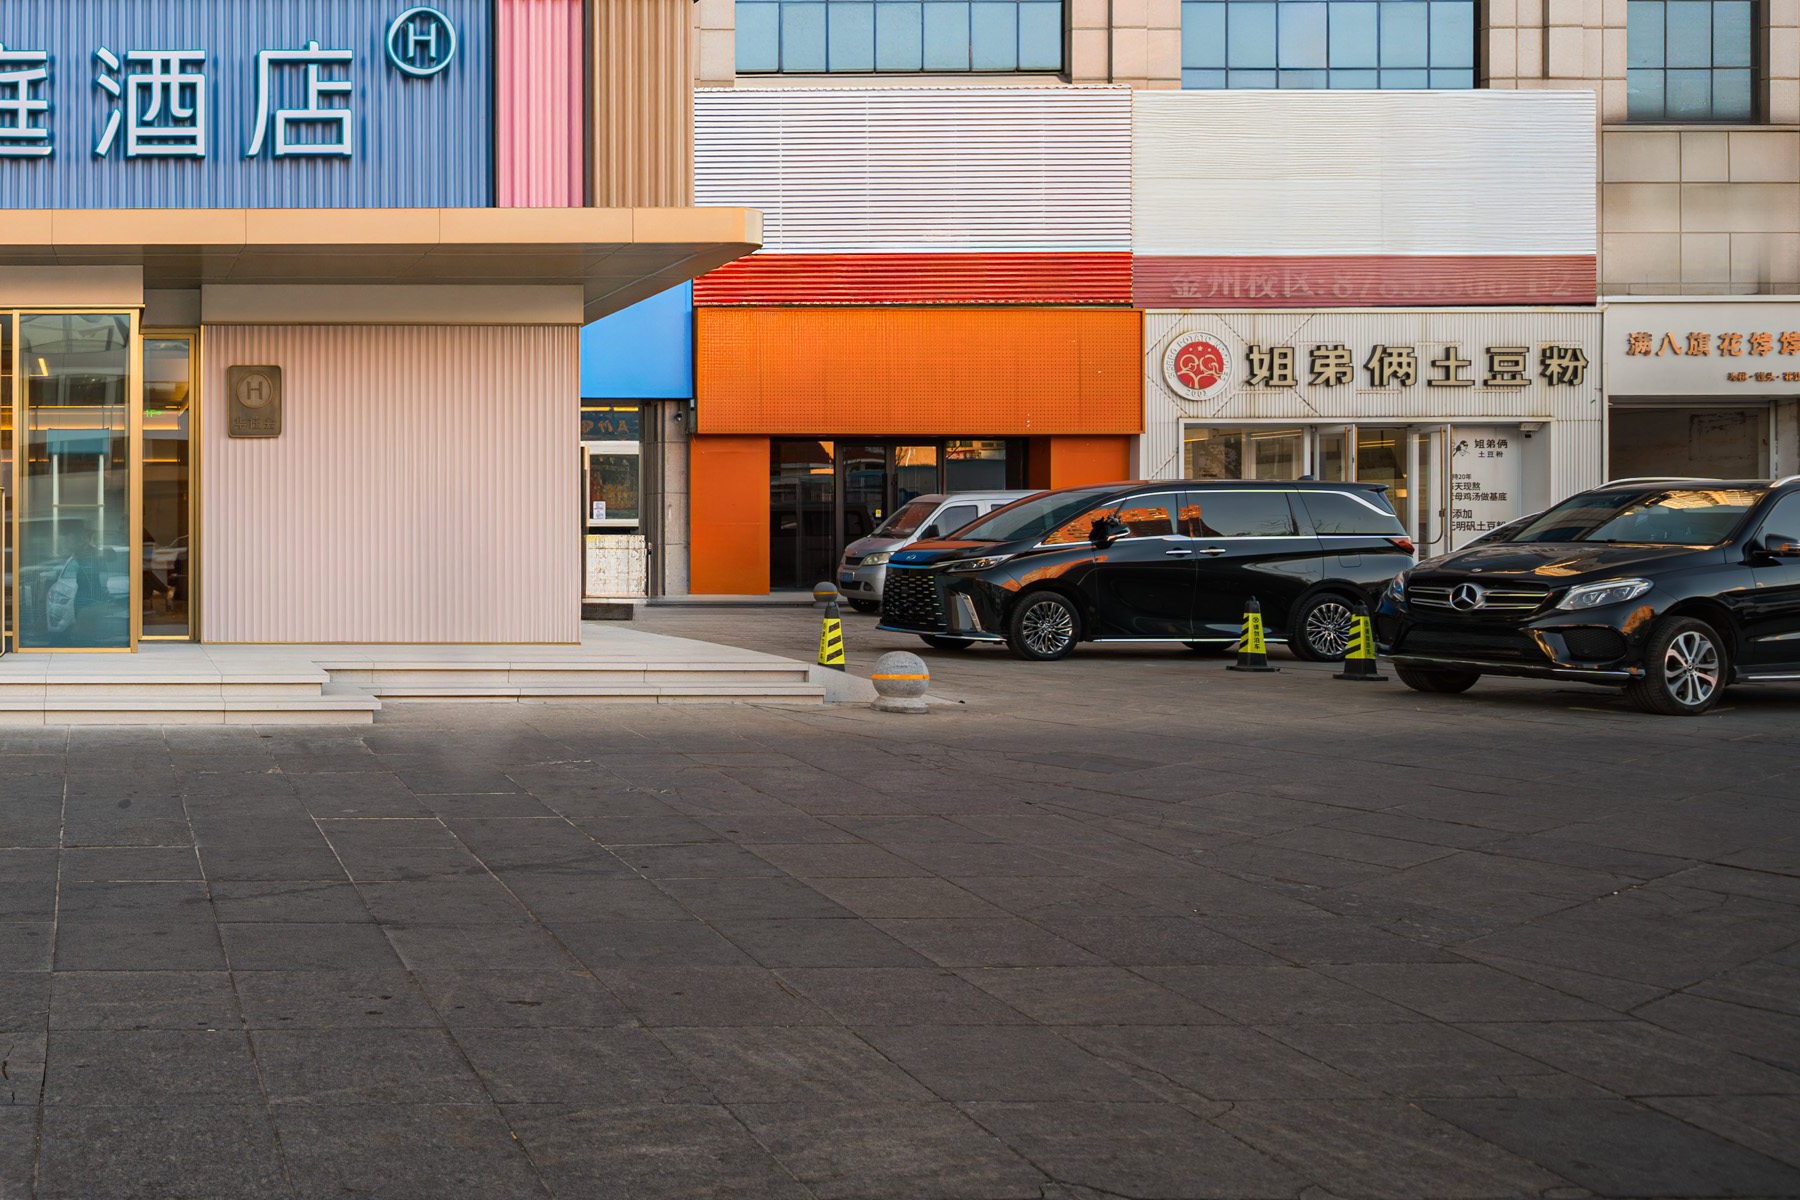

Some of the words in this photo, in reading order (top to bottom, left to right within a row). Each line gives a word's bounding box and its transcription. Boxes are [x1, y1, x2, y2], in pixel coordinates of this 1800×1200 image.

[1626, 331, 1800, 357] 满八旗花饽饽
[1246, 343, 1590, 388] 姐弟俩土豆粉
[1474, 439, 1508, 449] 姐弟俩
[1452, 482, 1481, 491] 天现熬
[1452, 492, 1507, 501] 母鸡汤做基底
